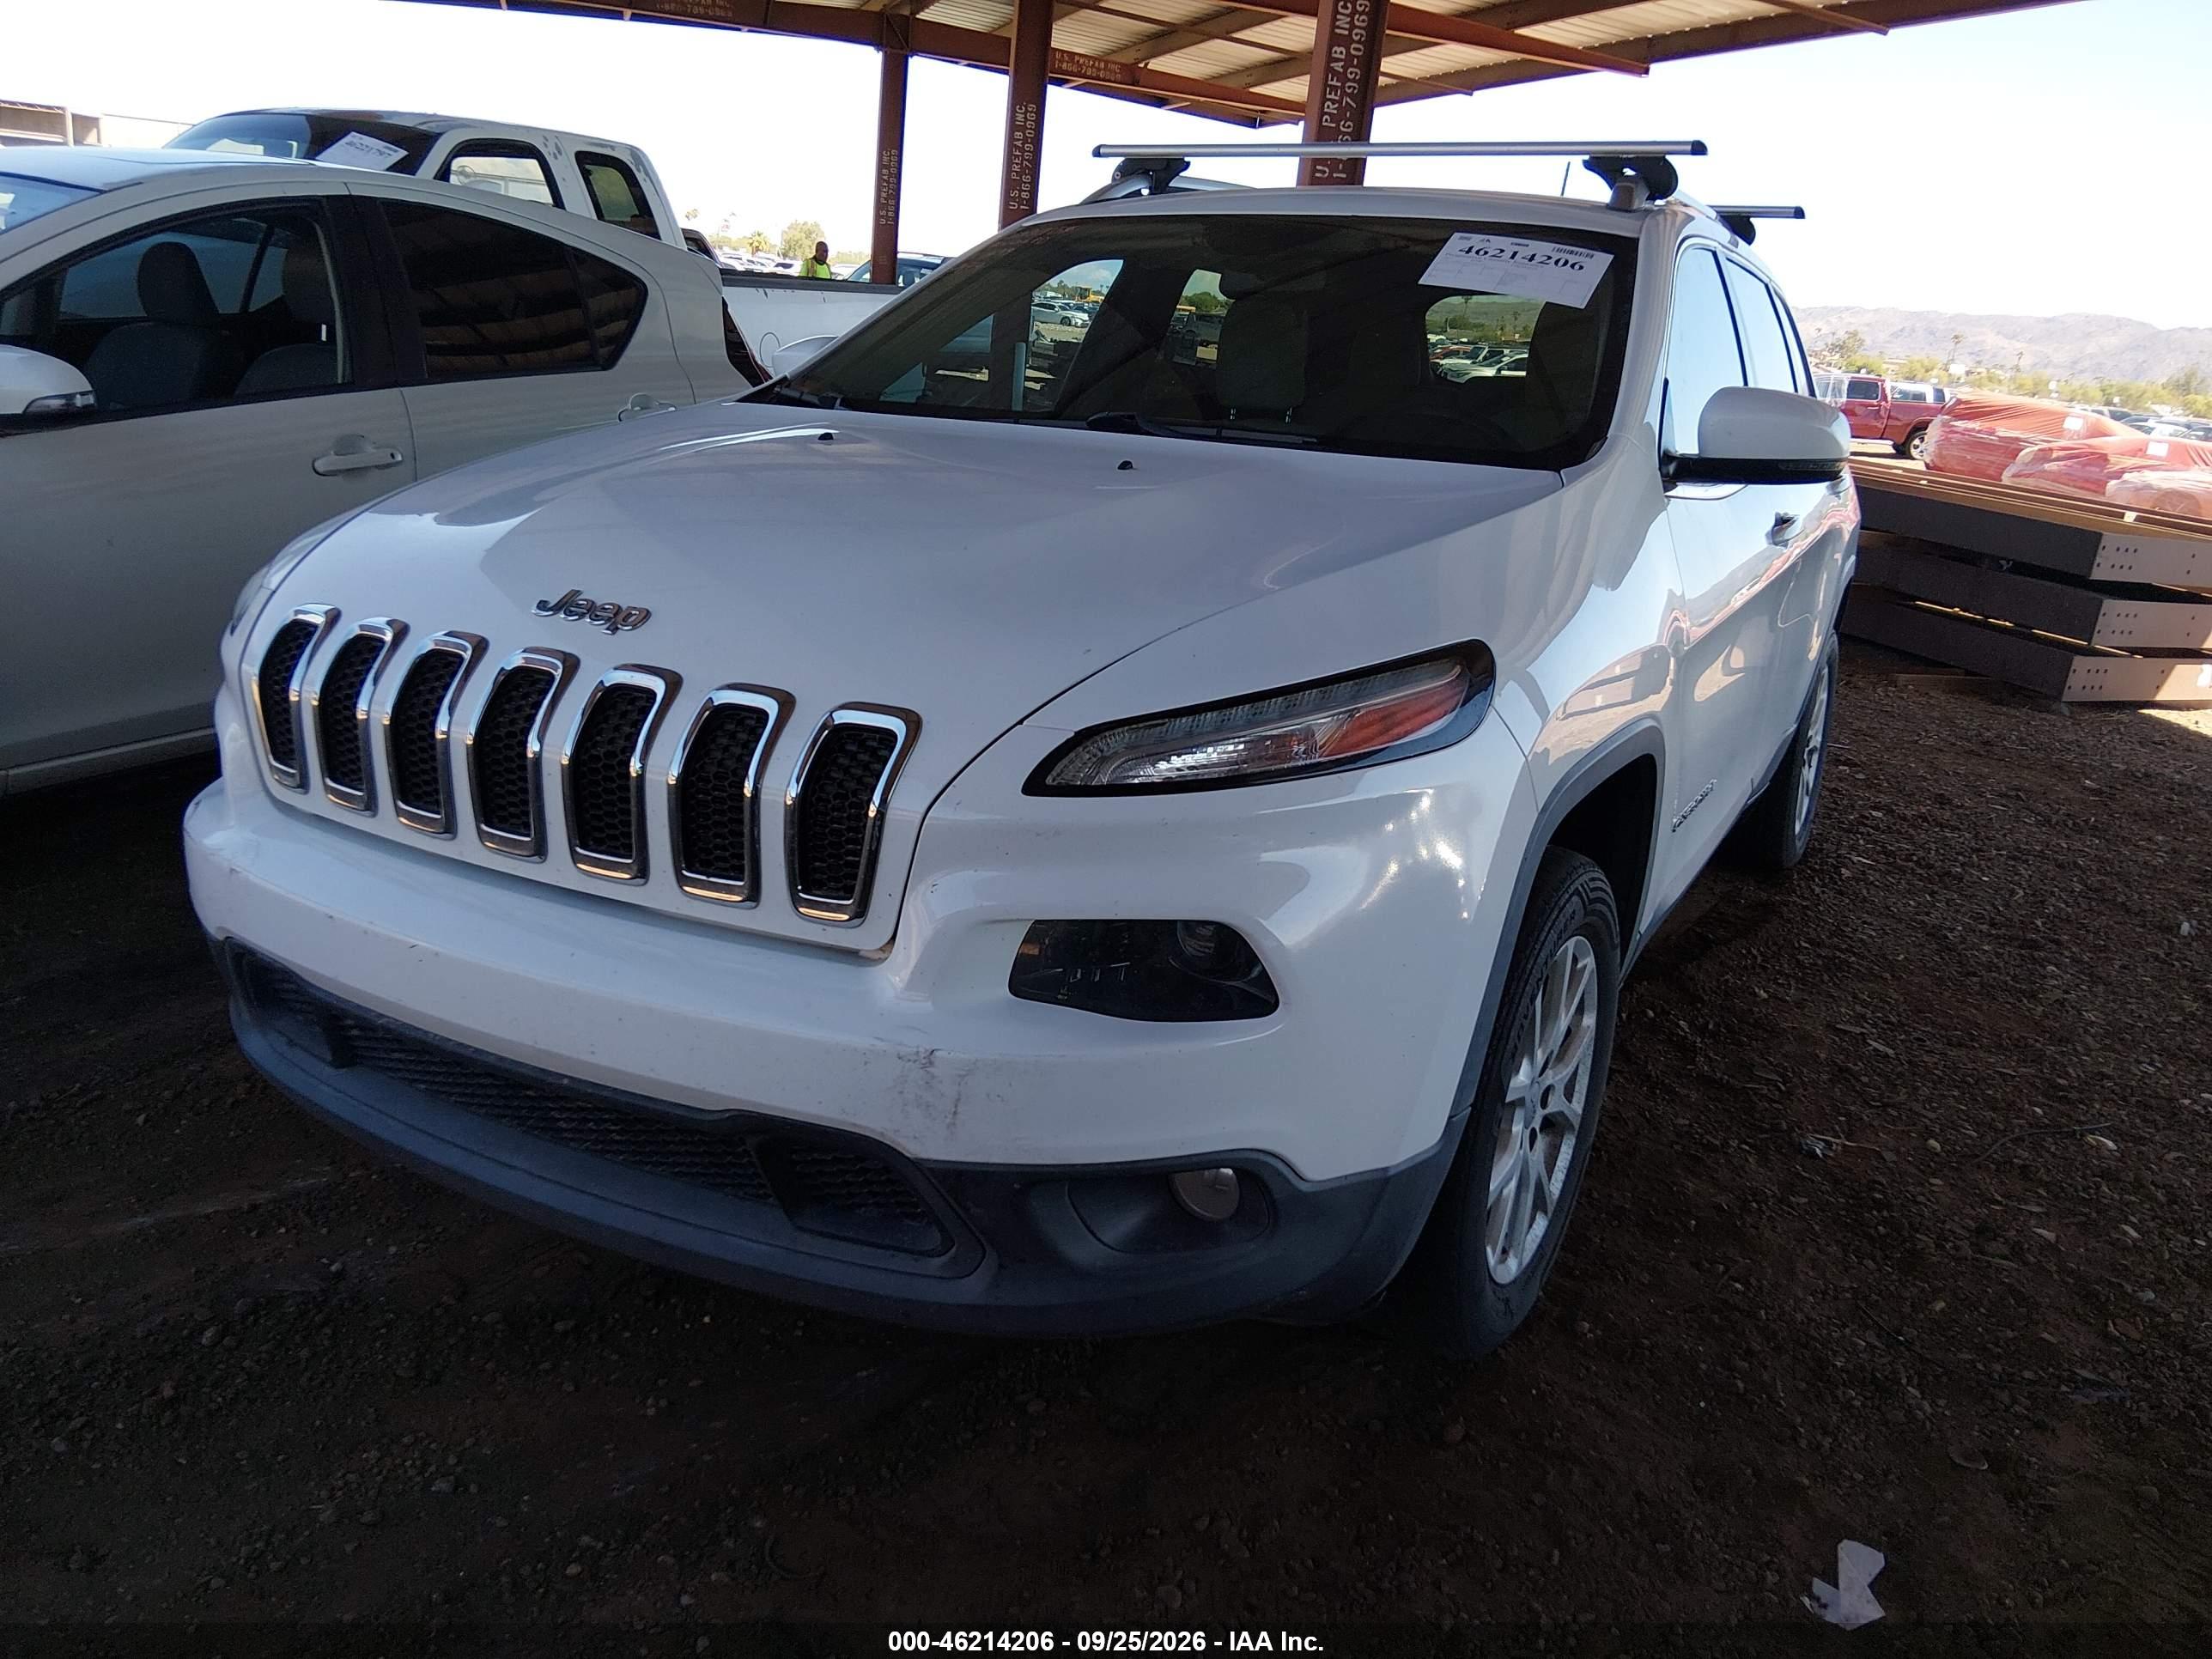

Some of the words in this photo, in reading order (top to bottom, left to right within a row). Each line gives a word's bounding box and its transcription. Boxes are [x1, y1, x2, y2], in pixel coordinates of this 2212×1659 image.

[1322, 46, 1346, 127] PREFAB
[1333, 0, 1370, 178] 1-66-799-0969
[1015, 101, 1026, 125] INC.
[1012, 131, 1024, 179] PREFAB
[1020, 104, 1037, 210] 1-866-799-0969
[1009, 186, 1019, 210] U.S.
[1458, 245, 1585, 271] 46214206
[531, 589, 652, 635] Jeep
